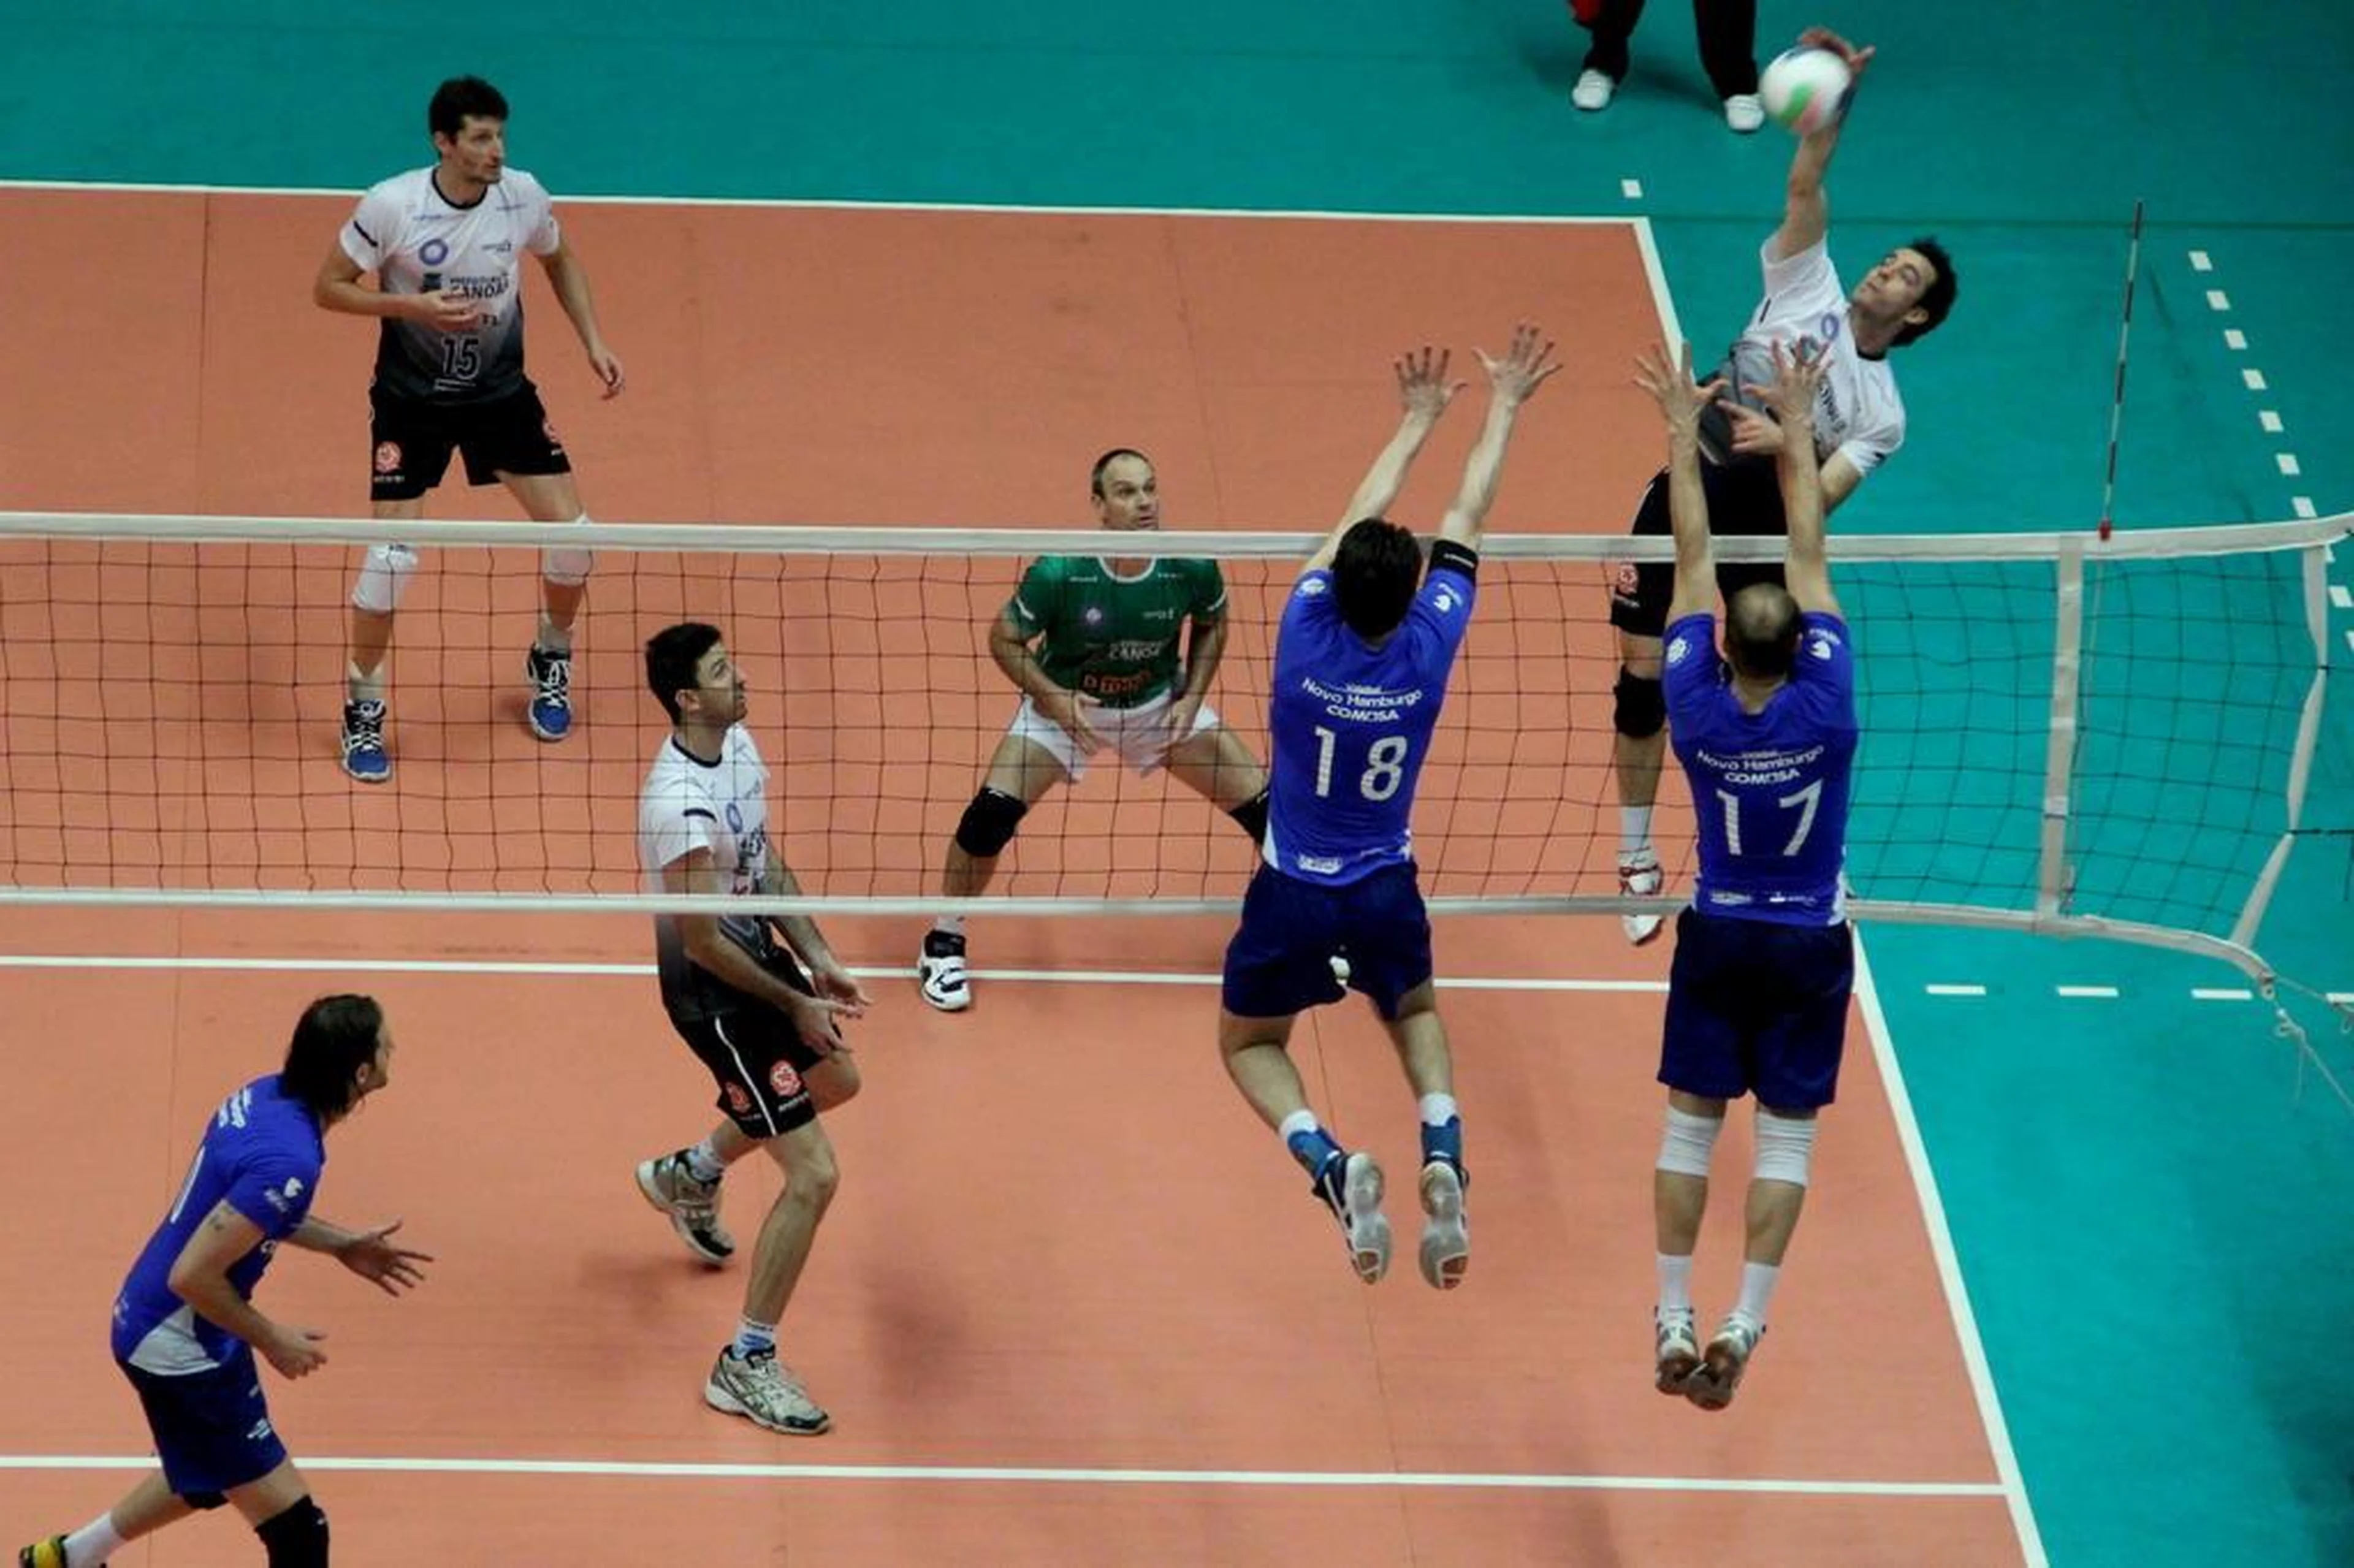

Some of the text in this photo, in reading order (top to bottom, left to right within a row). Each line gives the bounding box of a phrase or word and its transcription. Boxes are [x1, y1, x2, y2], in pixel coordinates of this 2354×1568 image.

[441, 335, 480, 380] 15
[1301, 677, 1343, 704] Novo
[1347, 688, 1423, 707] Hamburgo
[1314, 725, 1407, 801] 18
[1696, 748, 1740, 771] Novo
[1716, 778, 1824, 856] 17
